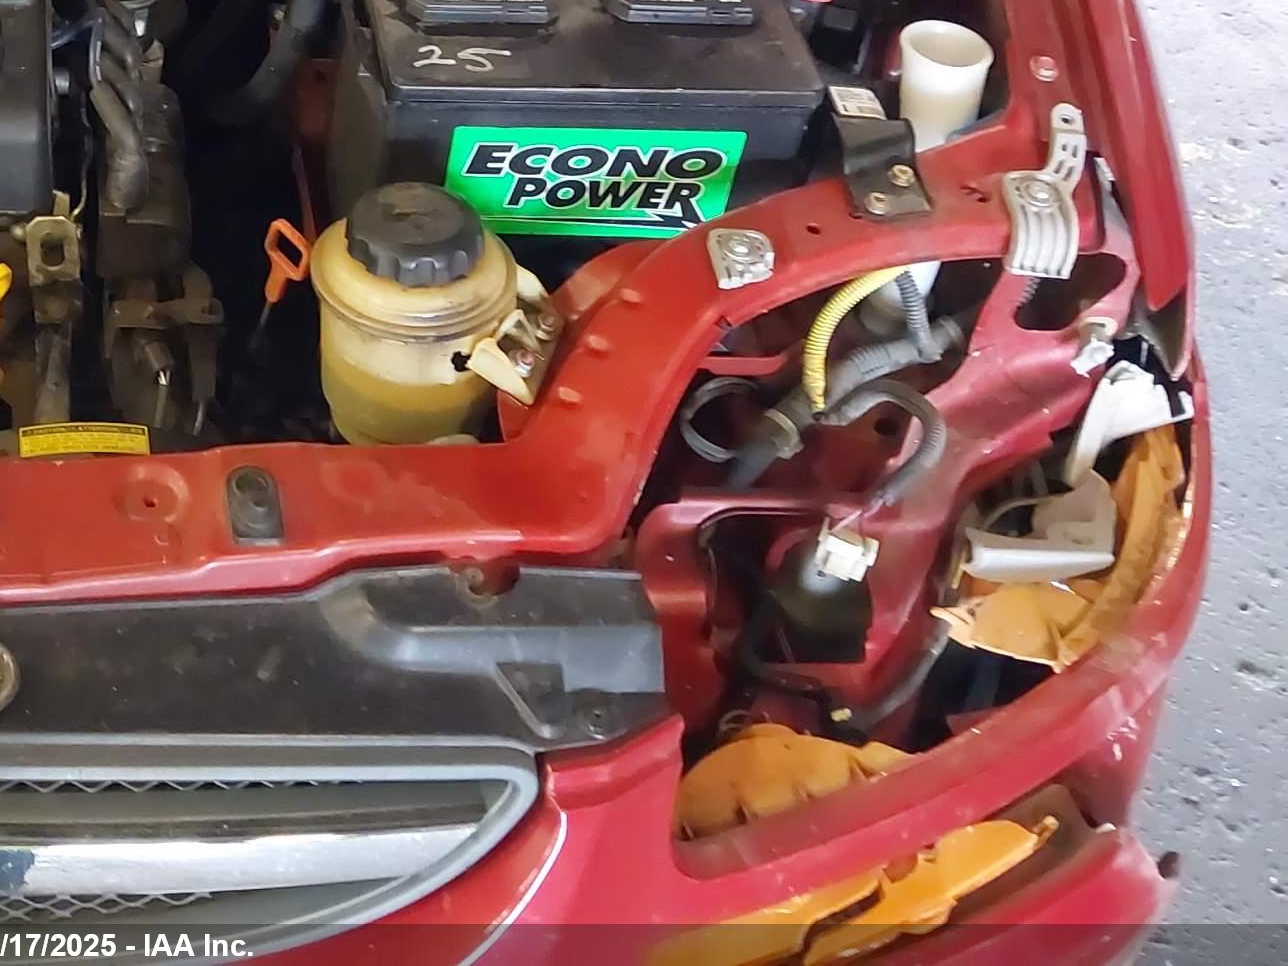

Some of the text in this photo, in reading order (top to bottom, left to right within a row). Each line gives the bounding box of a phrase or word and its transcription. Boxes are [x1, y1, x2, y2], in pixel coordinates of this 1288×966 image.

[413, 44, 513, 72] 25
[465, 143, 724, 179] ECONO
[505, 177, 703, 214] POWER
